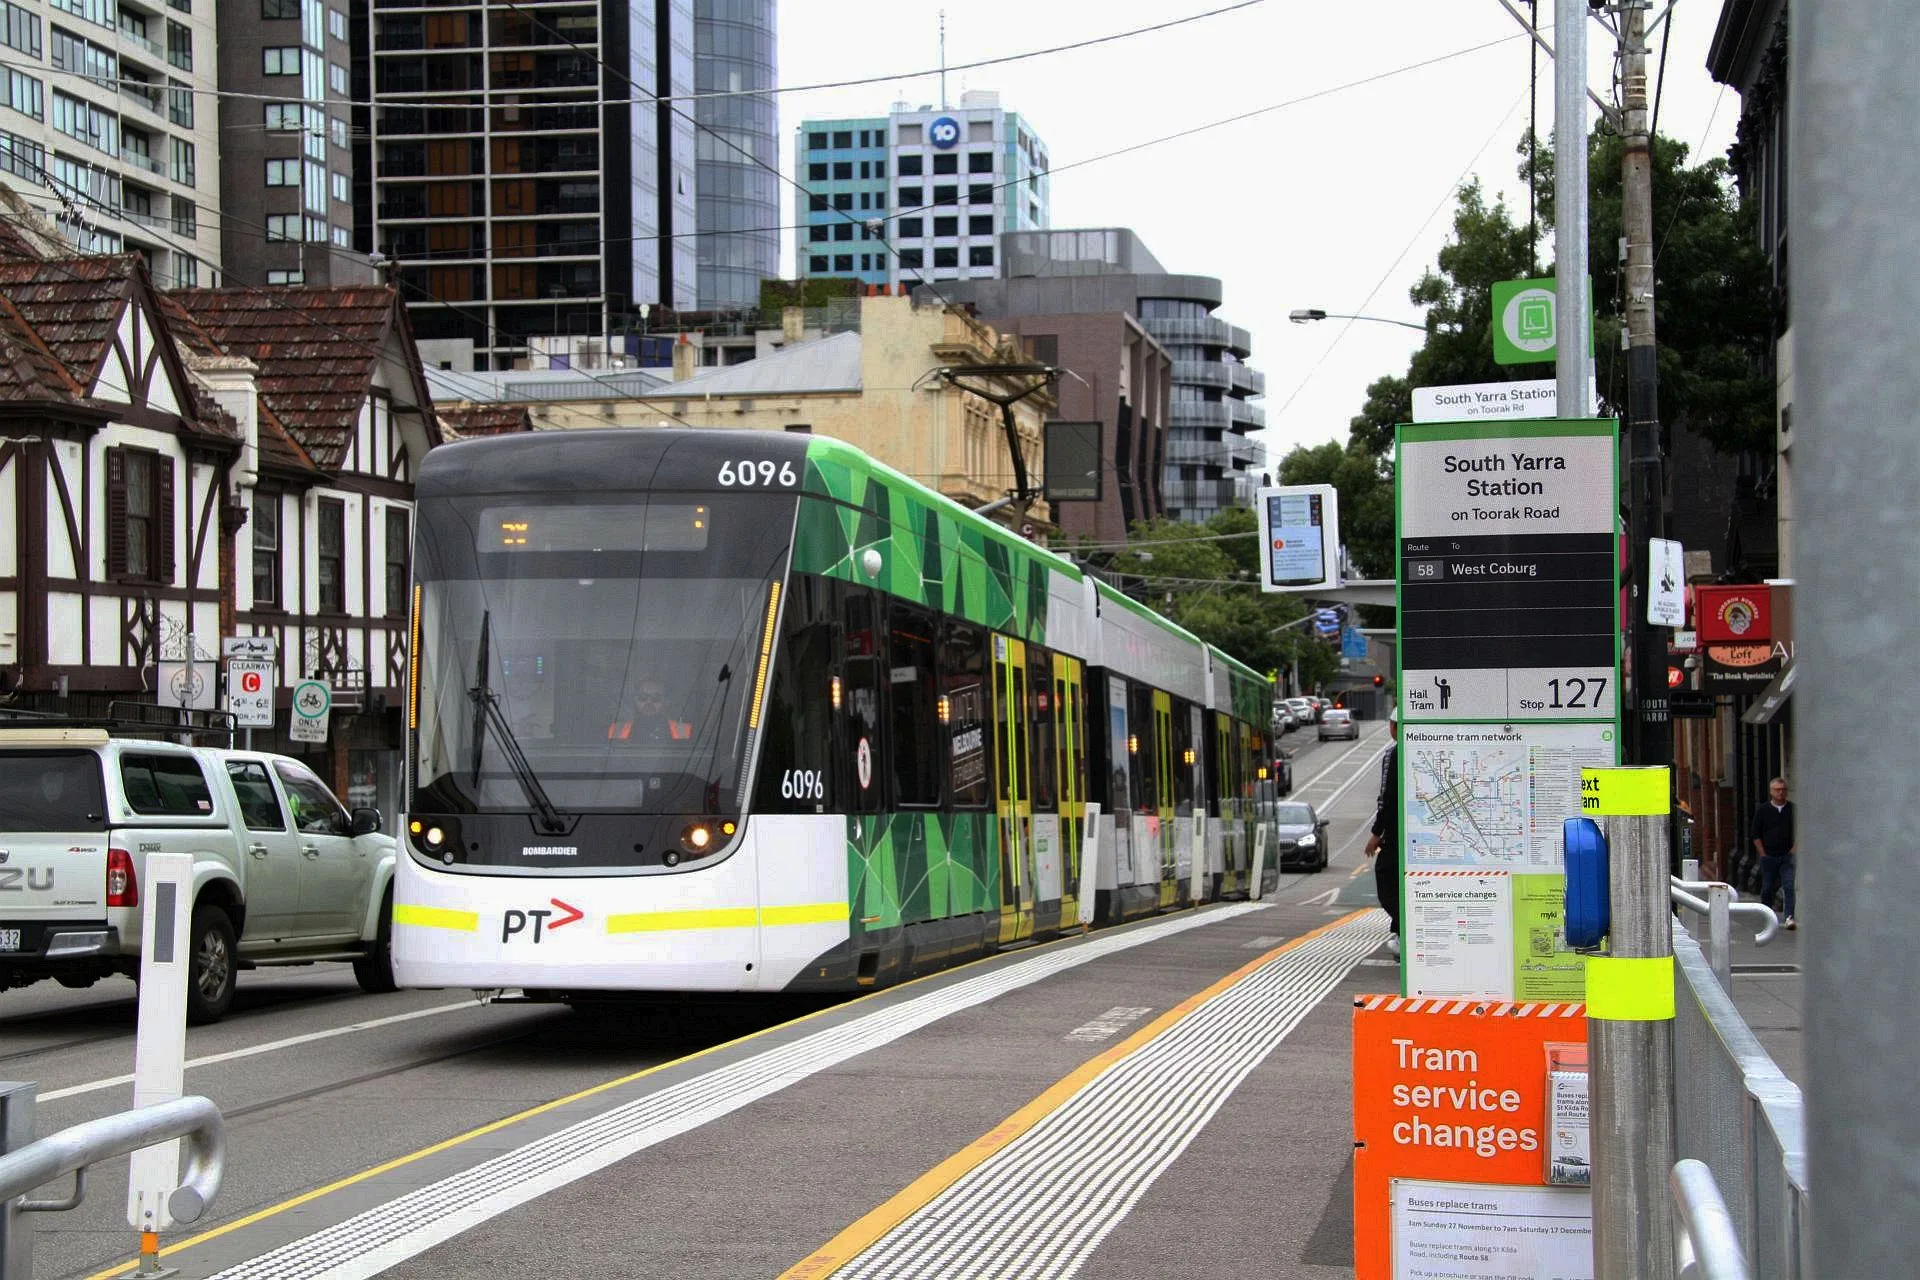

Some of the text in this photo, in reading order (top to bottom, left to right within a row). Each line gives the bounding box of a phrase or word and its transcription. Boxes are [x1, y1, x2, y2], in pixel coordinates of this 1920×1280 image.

[934, 124, 957, 141] 10
[1435, 387, 1556, 406] South Yarra Station
[1467, 403, 1524, 415] on Toorak Rd
[1444, 453, 1566, 473] South Yarra
[717, 461, 797, 487] 6096
[1466, 477, 1543, 497] Station
[1451, 506, 1560, 521] on Toorak Road
[1407, 543, 1429, 551] Route
[1451, 542, 1460, 550] To
[1417, 564, 1434, 577] 58
[1451, 562, 1537, 578] West Coburg
[1730, 650, 1752, 659] Loft
[231, 662, 271, 671] CLEARWAY
[246, 674, 257, 692] C
[1409, 689, 1428, 699] Hail
[1520, 678, 1607, 712] Stop 127
[1409, 701, 1434, 710] Tram
[1642, 699, 1668, 709] SOUTH
[299, 718, 321, 729] ONLY
[1642, 712, 1668, 722] YARRA
[1406, 732, 1522, 741] Melbourne tram network
[781, 769, 824, 800] 6096
[1581, 777, 1600, 791] ext
[1581, 796, 1600, 809] am
[522, 846, 578, 857] BOMBARDIER
[1415, 891, 1497, 900] Tram service changes
[1540, 911, 1557, 921] myki
[1392, 1038, 1478, 1073] Tram
[1392, 1080, 1521, 1112] service
[1392, 1116, 1538, 1158] changes
[1408, 1198, 1498, 1211] Buses replace trams
[1424, 1221, 1447, 1230] Sunday
[1458, 1223, 1492, 1231] November
[1519, 1226, 1549, 1234] Saturday
[1410, 1241, 1427, 1249] Buses
[1429, 1242, 1452, 1251] replace
[1454, 1243, 1472, 1251] trams
[1474, 1244, 1492, 1253] along
[1429, 1251, 1458, 1260] including
[1459, 1253, 1479, 1261] Route
[1410, 1269, 1423, 1277] Pick
[1425, 1271, 1433, 1279] up
[1440, 1271, 1468, 1279] brochure
